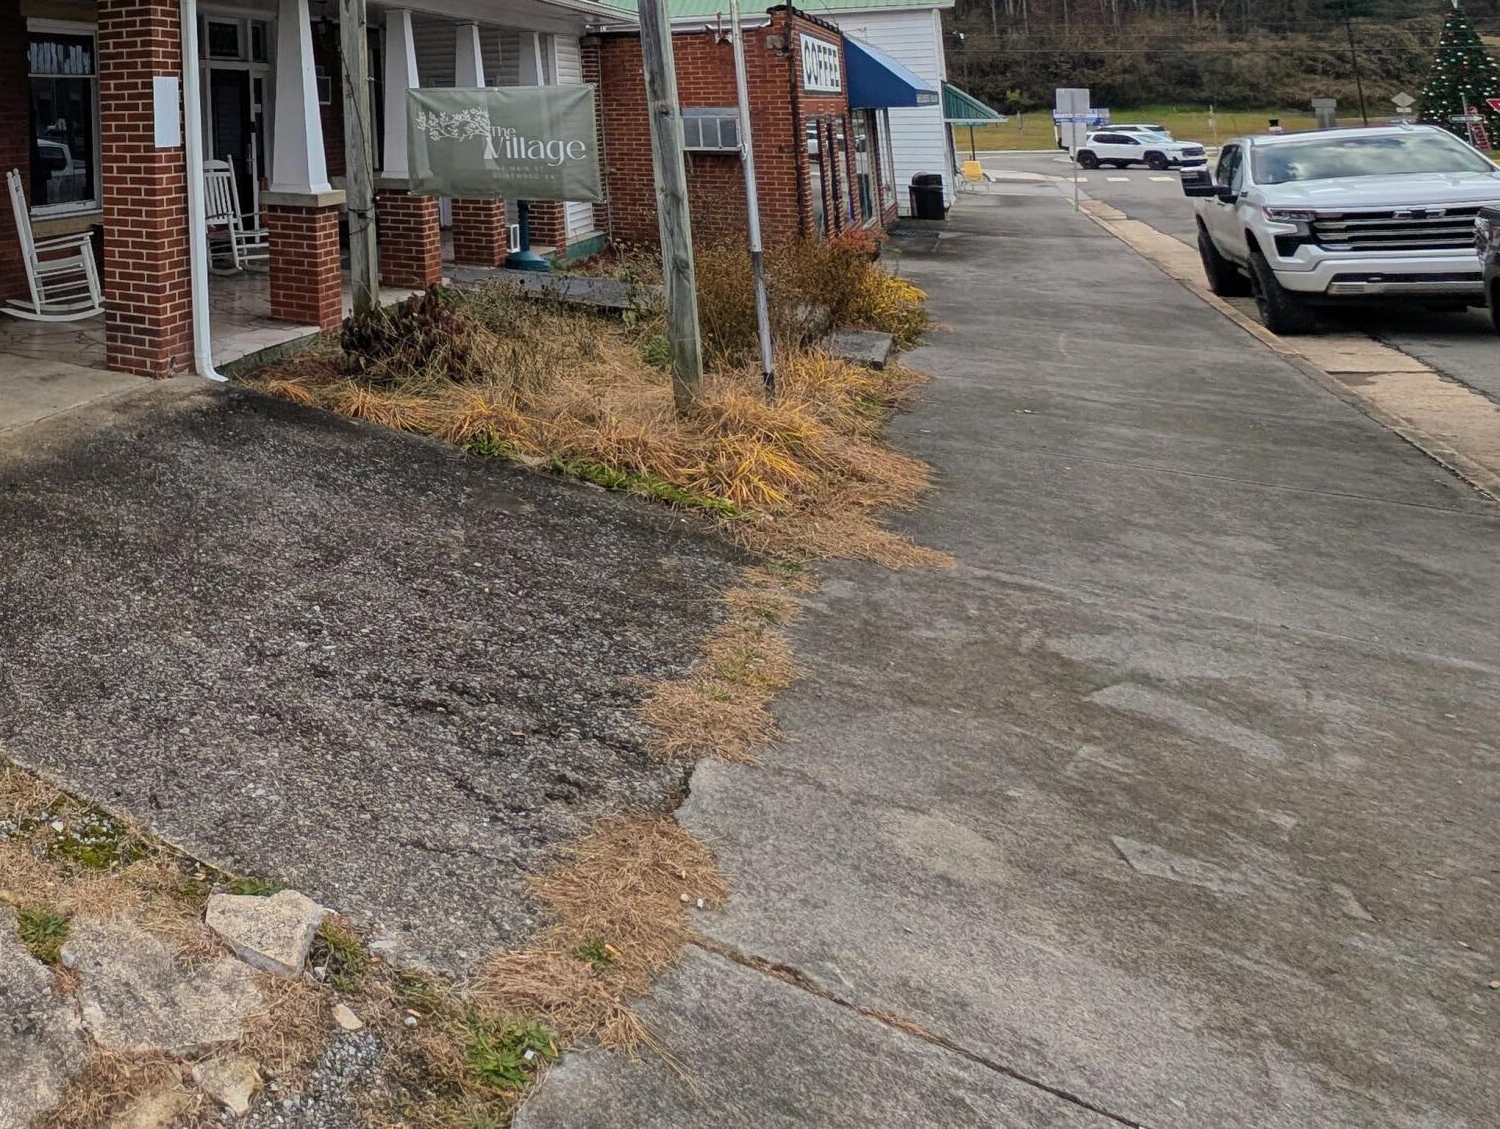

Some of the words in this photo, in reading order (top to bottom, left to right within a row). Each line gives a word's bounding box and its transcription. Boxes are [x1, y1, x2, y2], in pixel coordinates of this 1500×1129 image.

[804, 40, 840, 88] COFFEE
[492, 126, 516, 138] The
[485, 135, 586, 167] Village
